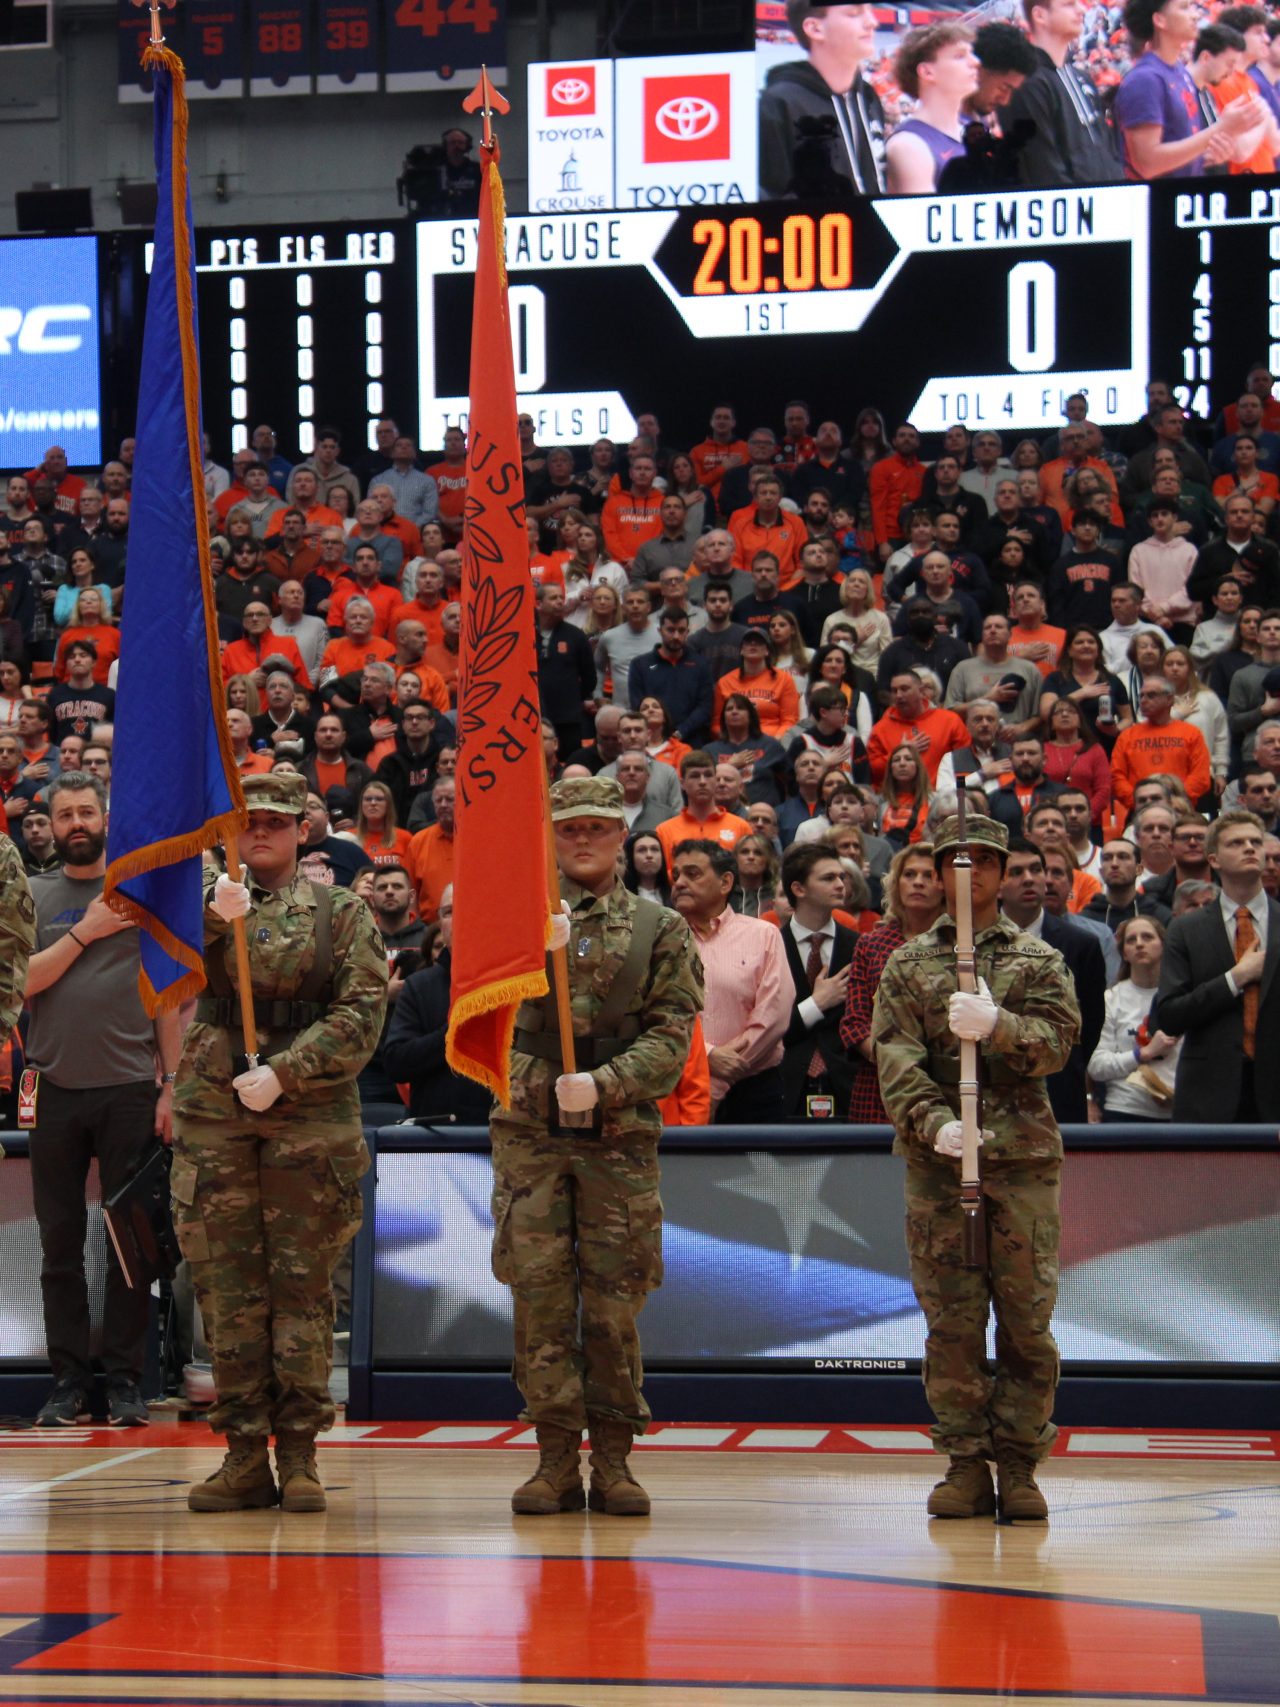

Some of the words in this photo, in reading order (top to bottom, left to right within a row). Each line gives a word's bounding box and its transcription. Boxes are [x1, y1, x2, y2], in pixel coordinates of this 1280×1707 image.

[395, 0, 498, 37] 44
[202, 26, 224, 56] 5
[259, 23, 302, 53] 88
[326, 20, 369, 50] 39
[536, 127, 604, 142] TOYOTA
[536, 194, 606, 212] CROUSE
[627, 183, 746, 209] TOYOTA
[1175, 192, 1227, 228] PLR
[925, 195, 1095, 245] CLEMSON
[210, 238, 259, 267] PTS
[279, 234, 326, 263] FLS
[346, 231, 396, 263] REB
[451, 220, 621, 266] SACUSE
[692, 213, 853, 297] 20:00
[1192, 272, 1212, 306] 4
[743, 302, 791, 333] 1ST
[1007, 261, 1056, 373] 0
[1192, 307, 1212, 342] 5
[1181, 346, 1212, 381] 11
[939, 392, 986, 421] TOL
[1002, 391, 1015, 416] 4
[1105, 386, 1117, 415] 0
[538, 409, 584, 437] FLS
[599, 407, 609, 434] 0
[1132, 735, 1185, 751] SYRACUSE
[1001, 942, 1019, 951] U.S.
[1022, 944, 1048, 954] ARMY
[813, 1359, 907, 1370] DAKTRONICS
